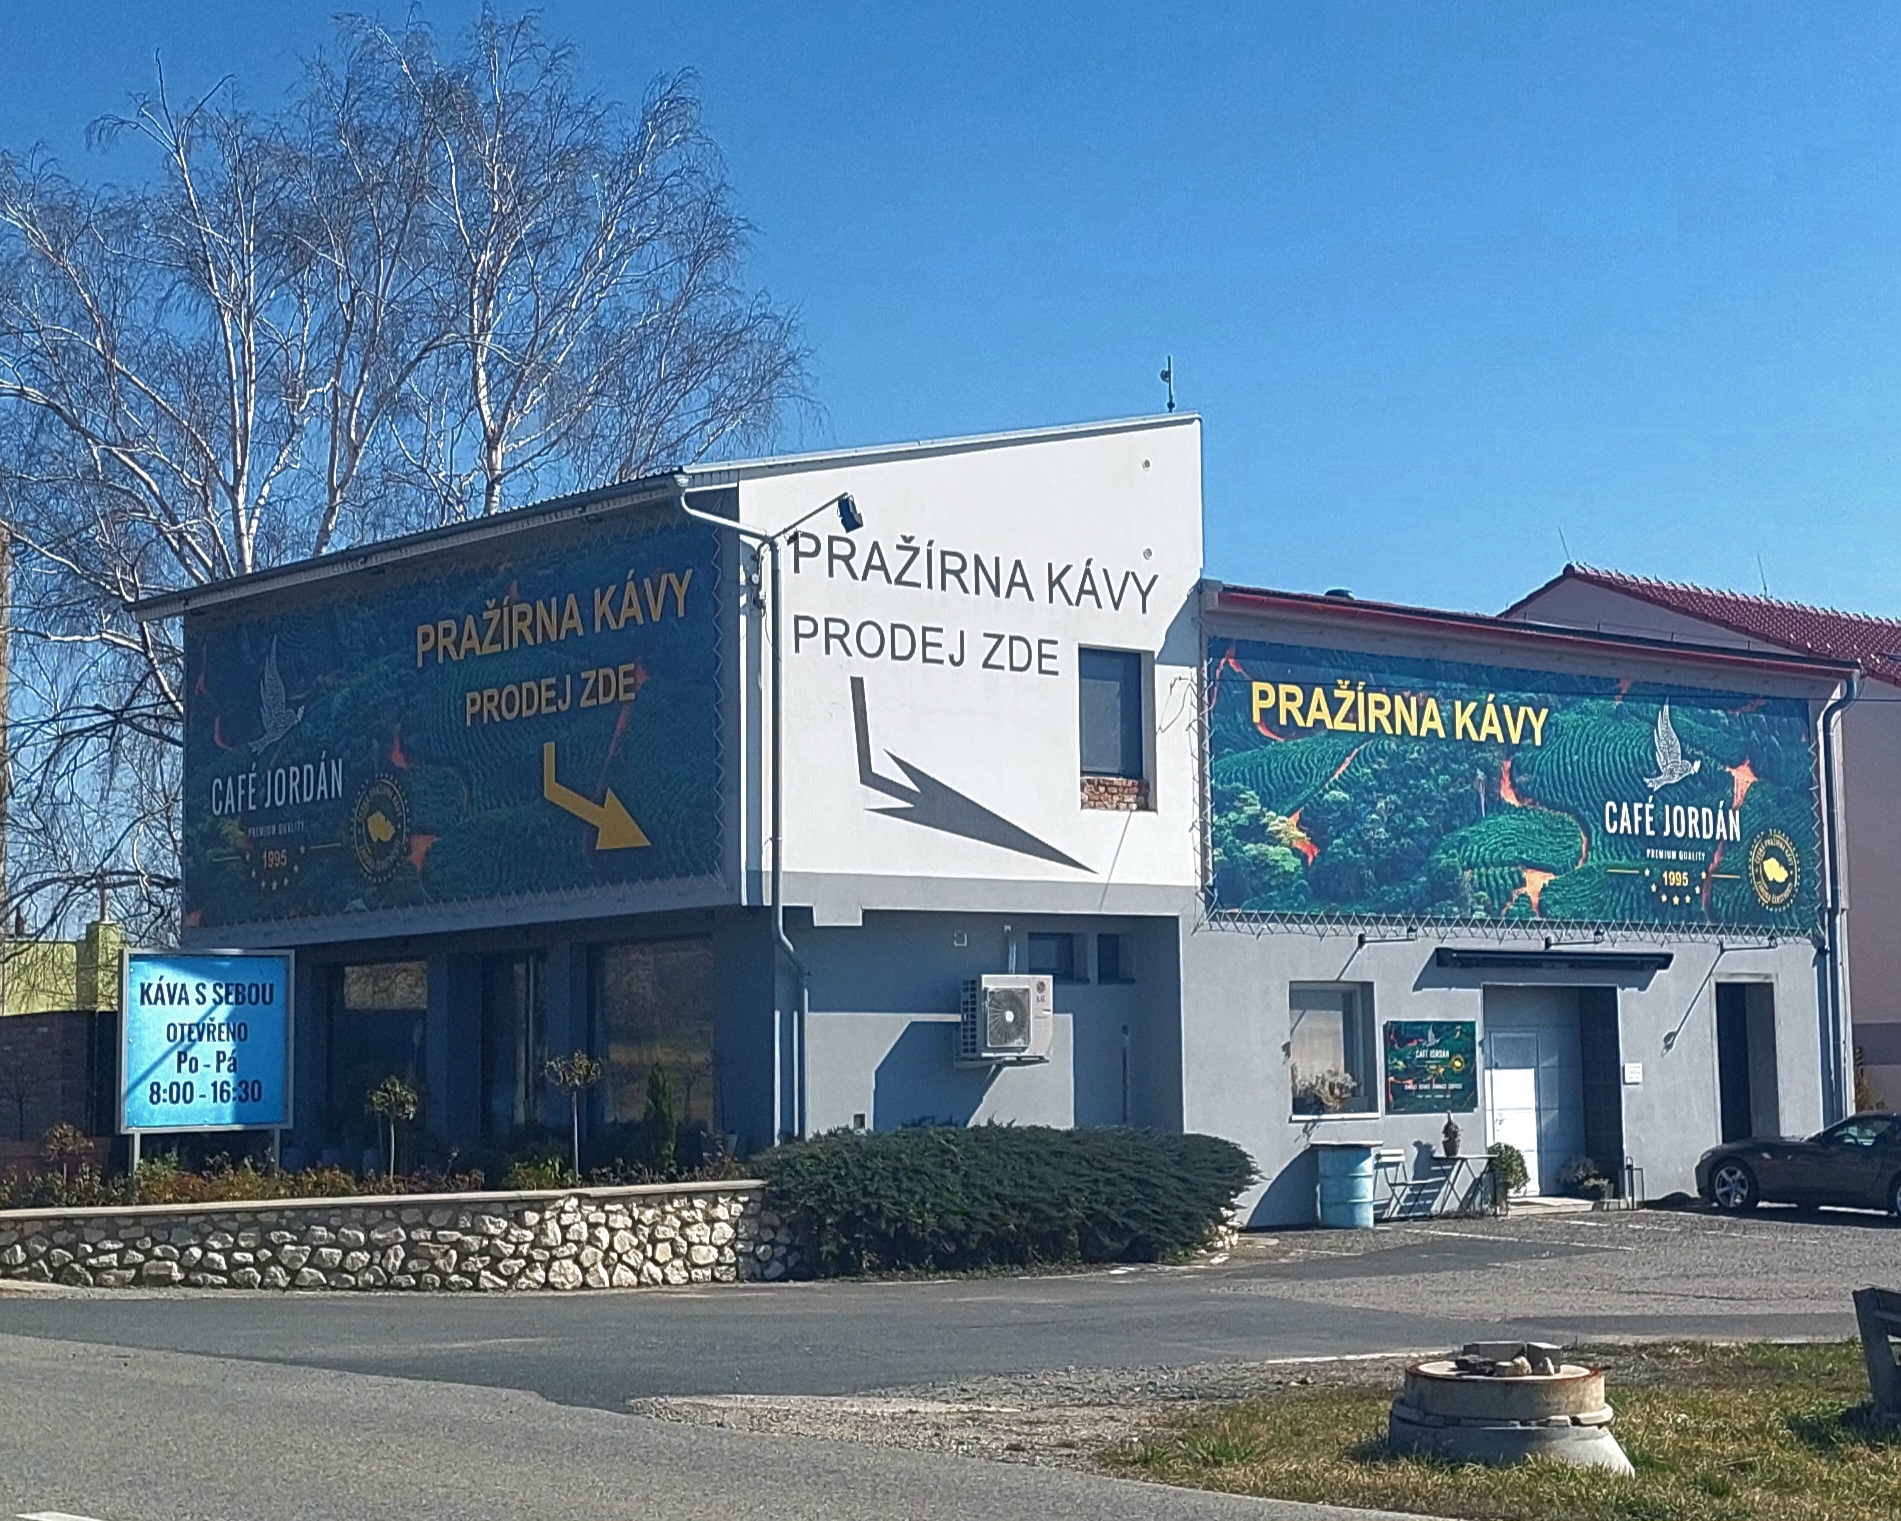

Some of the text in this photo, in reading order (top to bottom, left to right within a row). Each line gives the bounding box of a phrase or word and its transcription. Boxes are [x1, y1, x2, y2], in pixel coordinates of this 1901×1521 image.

[792, 531, 1159, 614] PRAŽÍRNA KÁVY
[416, 568, 693, 668] PRAŽÍRNA KÁVY
[793, 614, 1060, 677] PRODEJ ZDE
[466, 662, 636, 728] PRODEJ ZDE
[1251, 678, 1549, 747] PRAŽÍRNA KÁVY
[211, 750, 343, 816] CAFÉ JORDÁN
[1604, 795, 1741, 841] CAFÉ JORDÁN
[263, 849, 288, 870] 1995
[1646, 849, 1706, 863] PREMIUM QUALITY
[1662, 870, 1689, 887] 1995
[140, 975, 275, 1006] KÁVA S SEBOU
[166, 1016, 248, 1043] OTEVŘENO
[176, 1050, 199, 1074] Po
[215, 1048, 238, 1074] Pá
[149, 1080, 194, 1105] 8:00
[211, 1079, 263, 1104] 16:30
